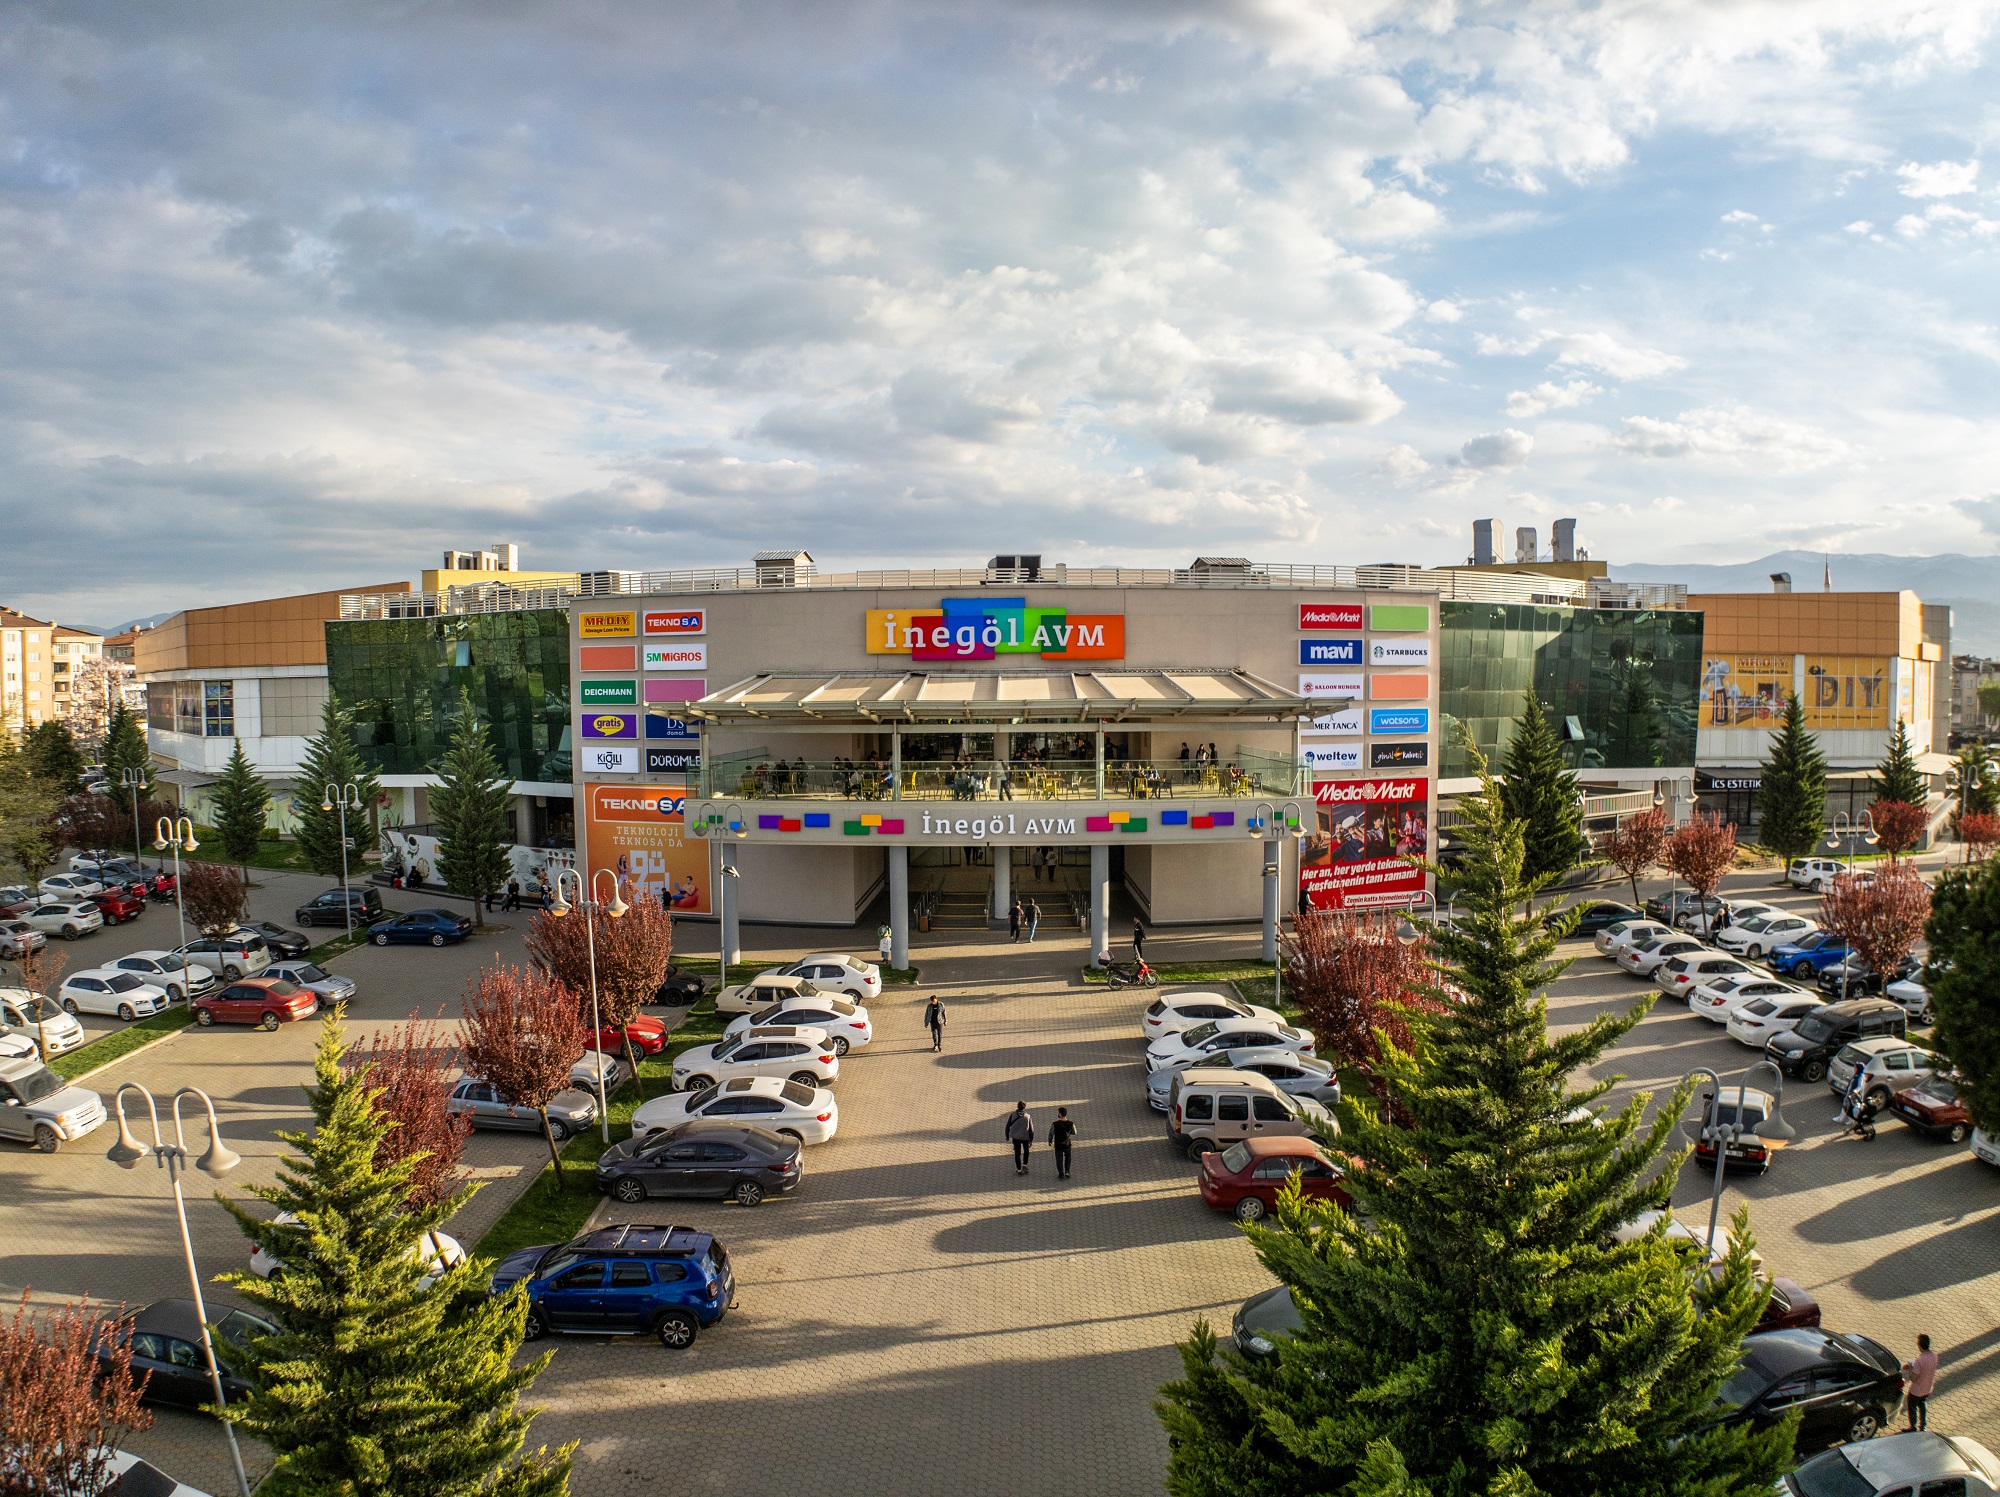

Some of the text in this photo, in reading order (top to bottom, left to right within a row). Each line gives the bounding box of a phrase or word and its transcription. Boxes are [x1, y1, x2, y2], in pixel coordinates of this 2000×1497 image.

[647, 618, 698, 627] TEKNOSA
[1302, 612, 1360, 622] Media Markt
[1031, 625, 1105, 647] AVM
[1310, 642, 1353, 659] mavi
[584, 688, 632, 696] DEICHMANN
[1815, 676, 1882, 707] DIY
[596, 717, 621, 729] gratis
[1380, 717, 1419, 725] watsons
[650, 755, 700, 767] DÜRÜMLE
[1316, 751, 1357, 761] weltew
[1315, 781, 1415, 802] Media Markt
[922, 810, 1076, 839] İnegöl AVM
[612, 836, 683, 848] TEKNOSA'DA
[1302, 869, 1318, 880] Her
[1319, 868, 1332, 878] an,
[1334, 865, 1350, 876] her
[1350, 861, 1377, 875] yerde
[1366, 873, 1383, 885] tam
[1384, 868, 1418, 882] zamanı!
